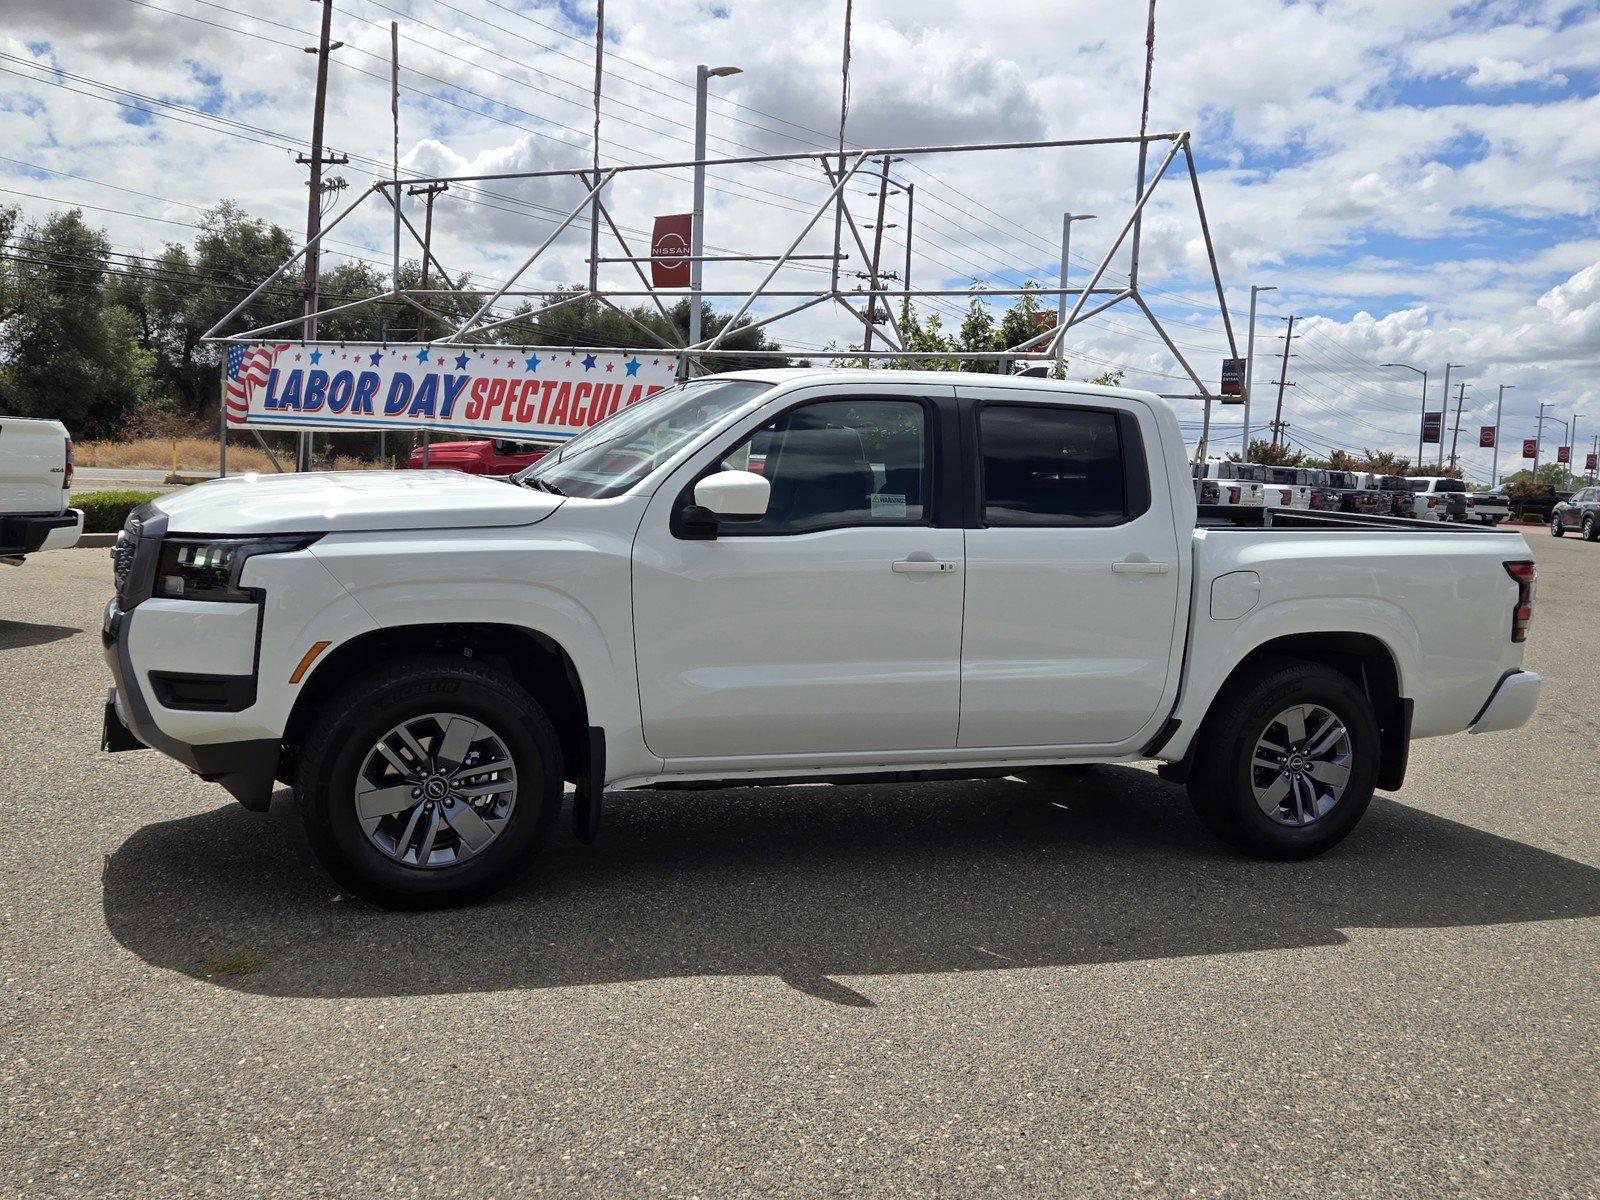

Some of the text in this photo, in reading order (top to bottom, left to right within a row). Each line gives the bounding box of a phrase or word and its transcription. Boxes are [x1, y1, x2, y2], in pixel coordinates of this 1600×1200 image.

[264, 368, 665, 427] LABOR DAY SPECTACUL
